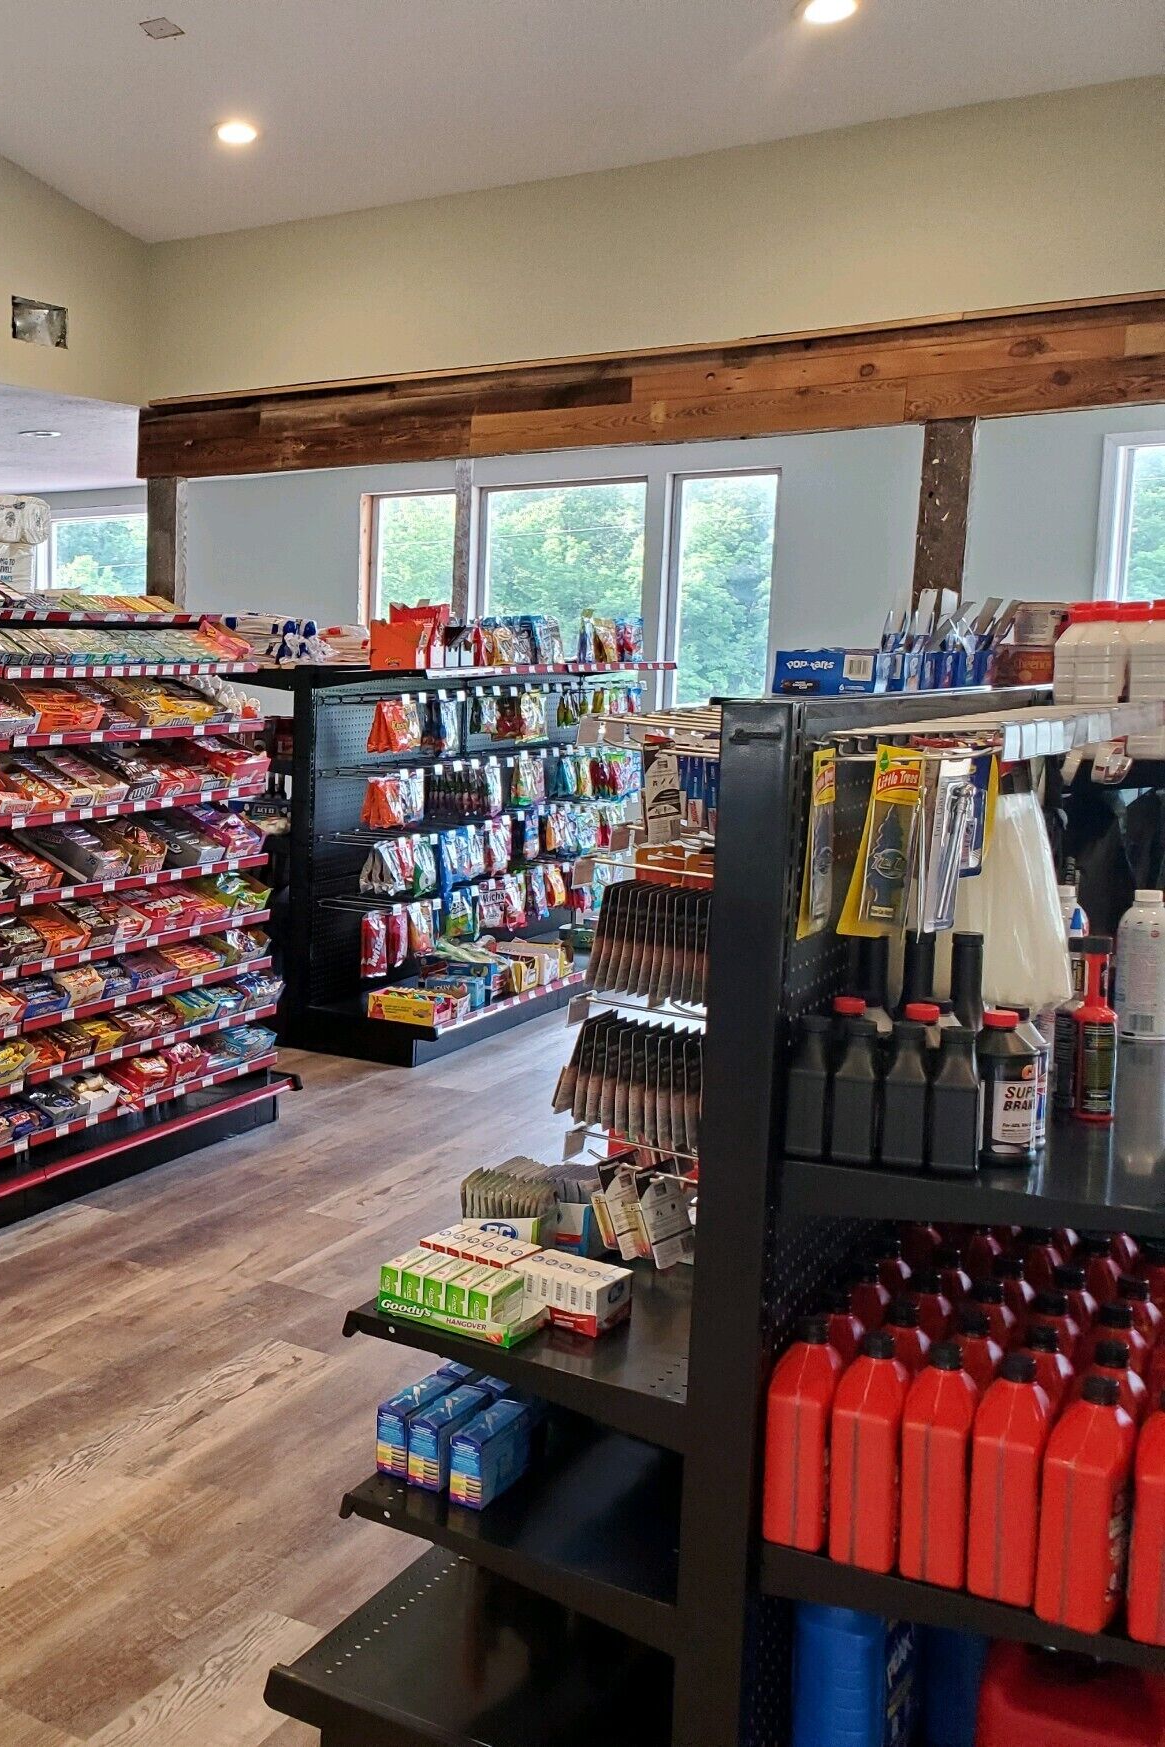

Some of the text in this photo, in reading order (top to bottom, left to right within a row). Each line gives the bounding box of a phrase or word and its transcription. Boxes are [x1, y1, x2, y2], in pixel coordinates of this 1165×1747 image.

[877, 771, 919, 789] Little Trees
[381, 1299, 432, 1318] Goody's
[446, 1317, 487, 1331] HANGOVER
